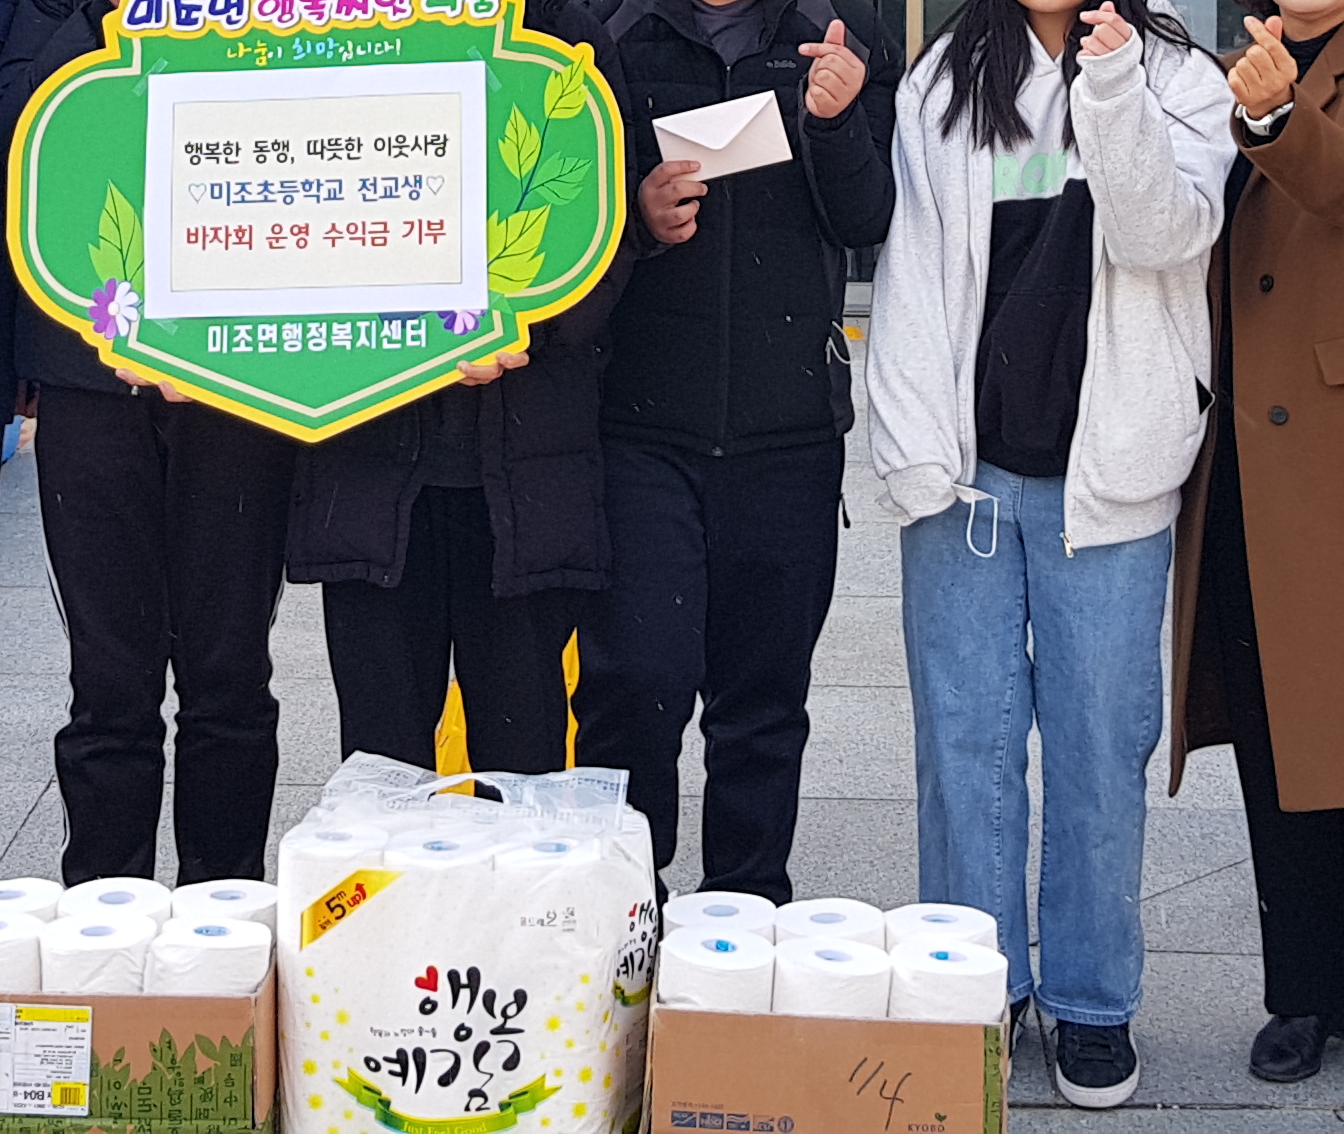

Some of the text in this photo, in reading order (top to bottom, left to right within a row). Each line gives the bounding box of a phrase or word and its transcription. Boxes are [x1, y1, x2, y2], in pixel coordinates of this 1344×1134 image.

[226, 37, 401, 67] 나눔이 희망입니다!
[184, 133, 449, 165] 행복한 동행, 따뜻한 이웃사랑
[209, 174, 423, 206] 미조초등학교 전교생
[186, 218, 447, 251] 바자회 운영 수익금 기부
[207, 318, 428, 354] 미조면행정복지센터
[907, 1123, 946, 1133] KYOBO
